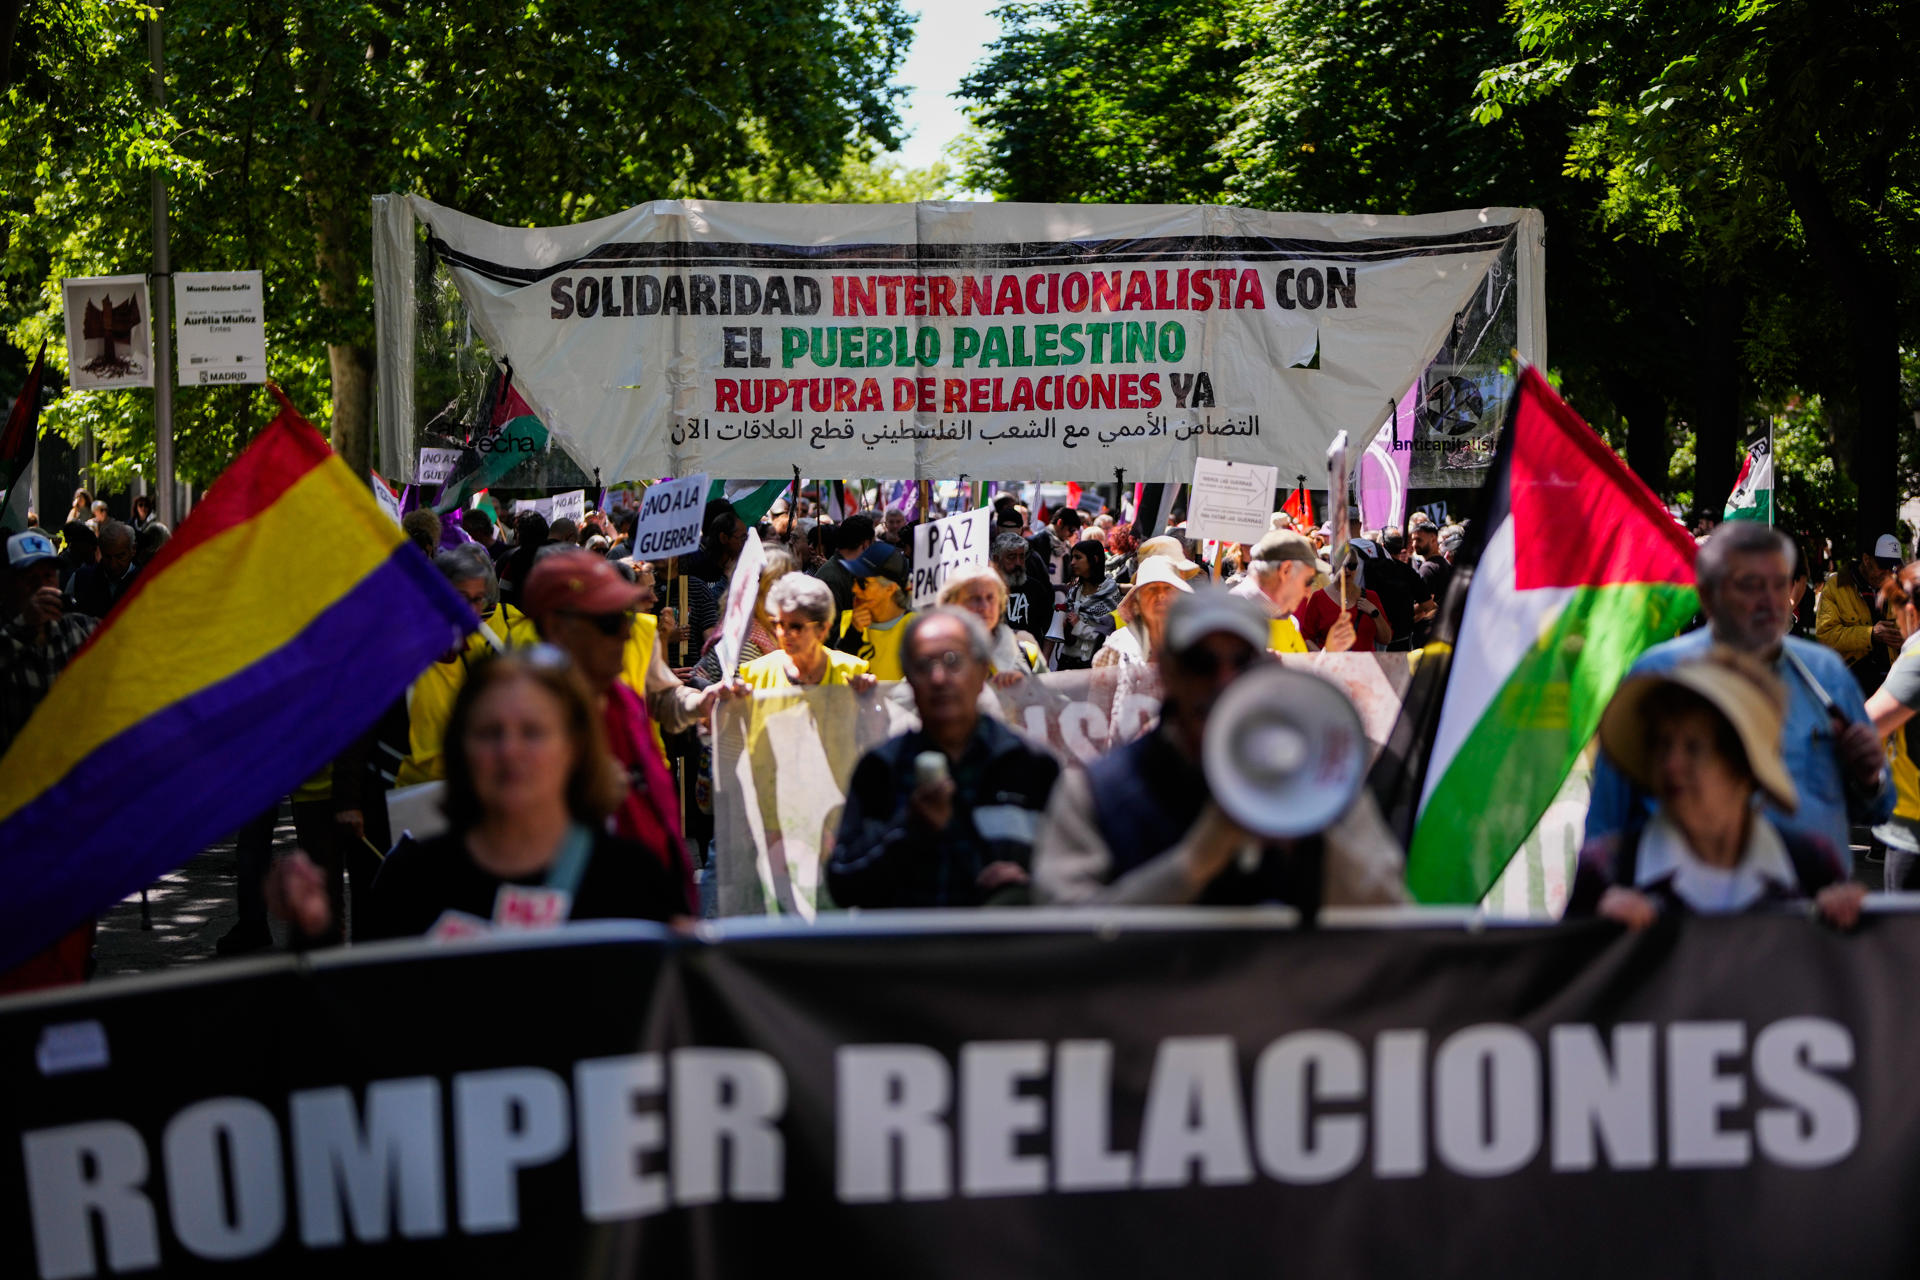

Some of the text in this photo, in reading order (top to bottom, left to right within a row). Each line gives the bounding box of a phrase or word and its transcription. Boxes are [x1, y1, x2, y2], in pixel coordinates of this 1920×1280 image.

[551, 267, 1358, 320] SOLIDARIDAD INTERNACIONALISTA CON
[222, 314, 257, 324] Muñoz
[722, 320, 1187, 369] EL PUEBLO PALESTINO
[210, 371, 247, 382] MADRID
[715, 371, 1216, 413] RUPTURA DE RELACIONES YA
[716, 418, 803, 441] العلاقات
[810, 417, 855, 449] قطع
[861, 418, 972, 451] الفلسطيني
[979, 416, 1056, 446] الشعب
[1063, 422, 1090, 448] مع
[1174, 414, 1259, 441] التضامن
[640, 492, 671, 522] ¡NO
[671, 490, 682, 512] A
[683, 485, 700, 509] LA
[640, 522, 700, 554] GUERRA!
[928, 518, 973, 559] PAZ
[21, 1016, 1861, 1280] ROMPER RELACIONES
